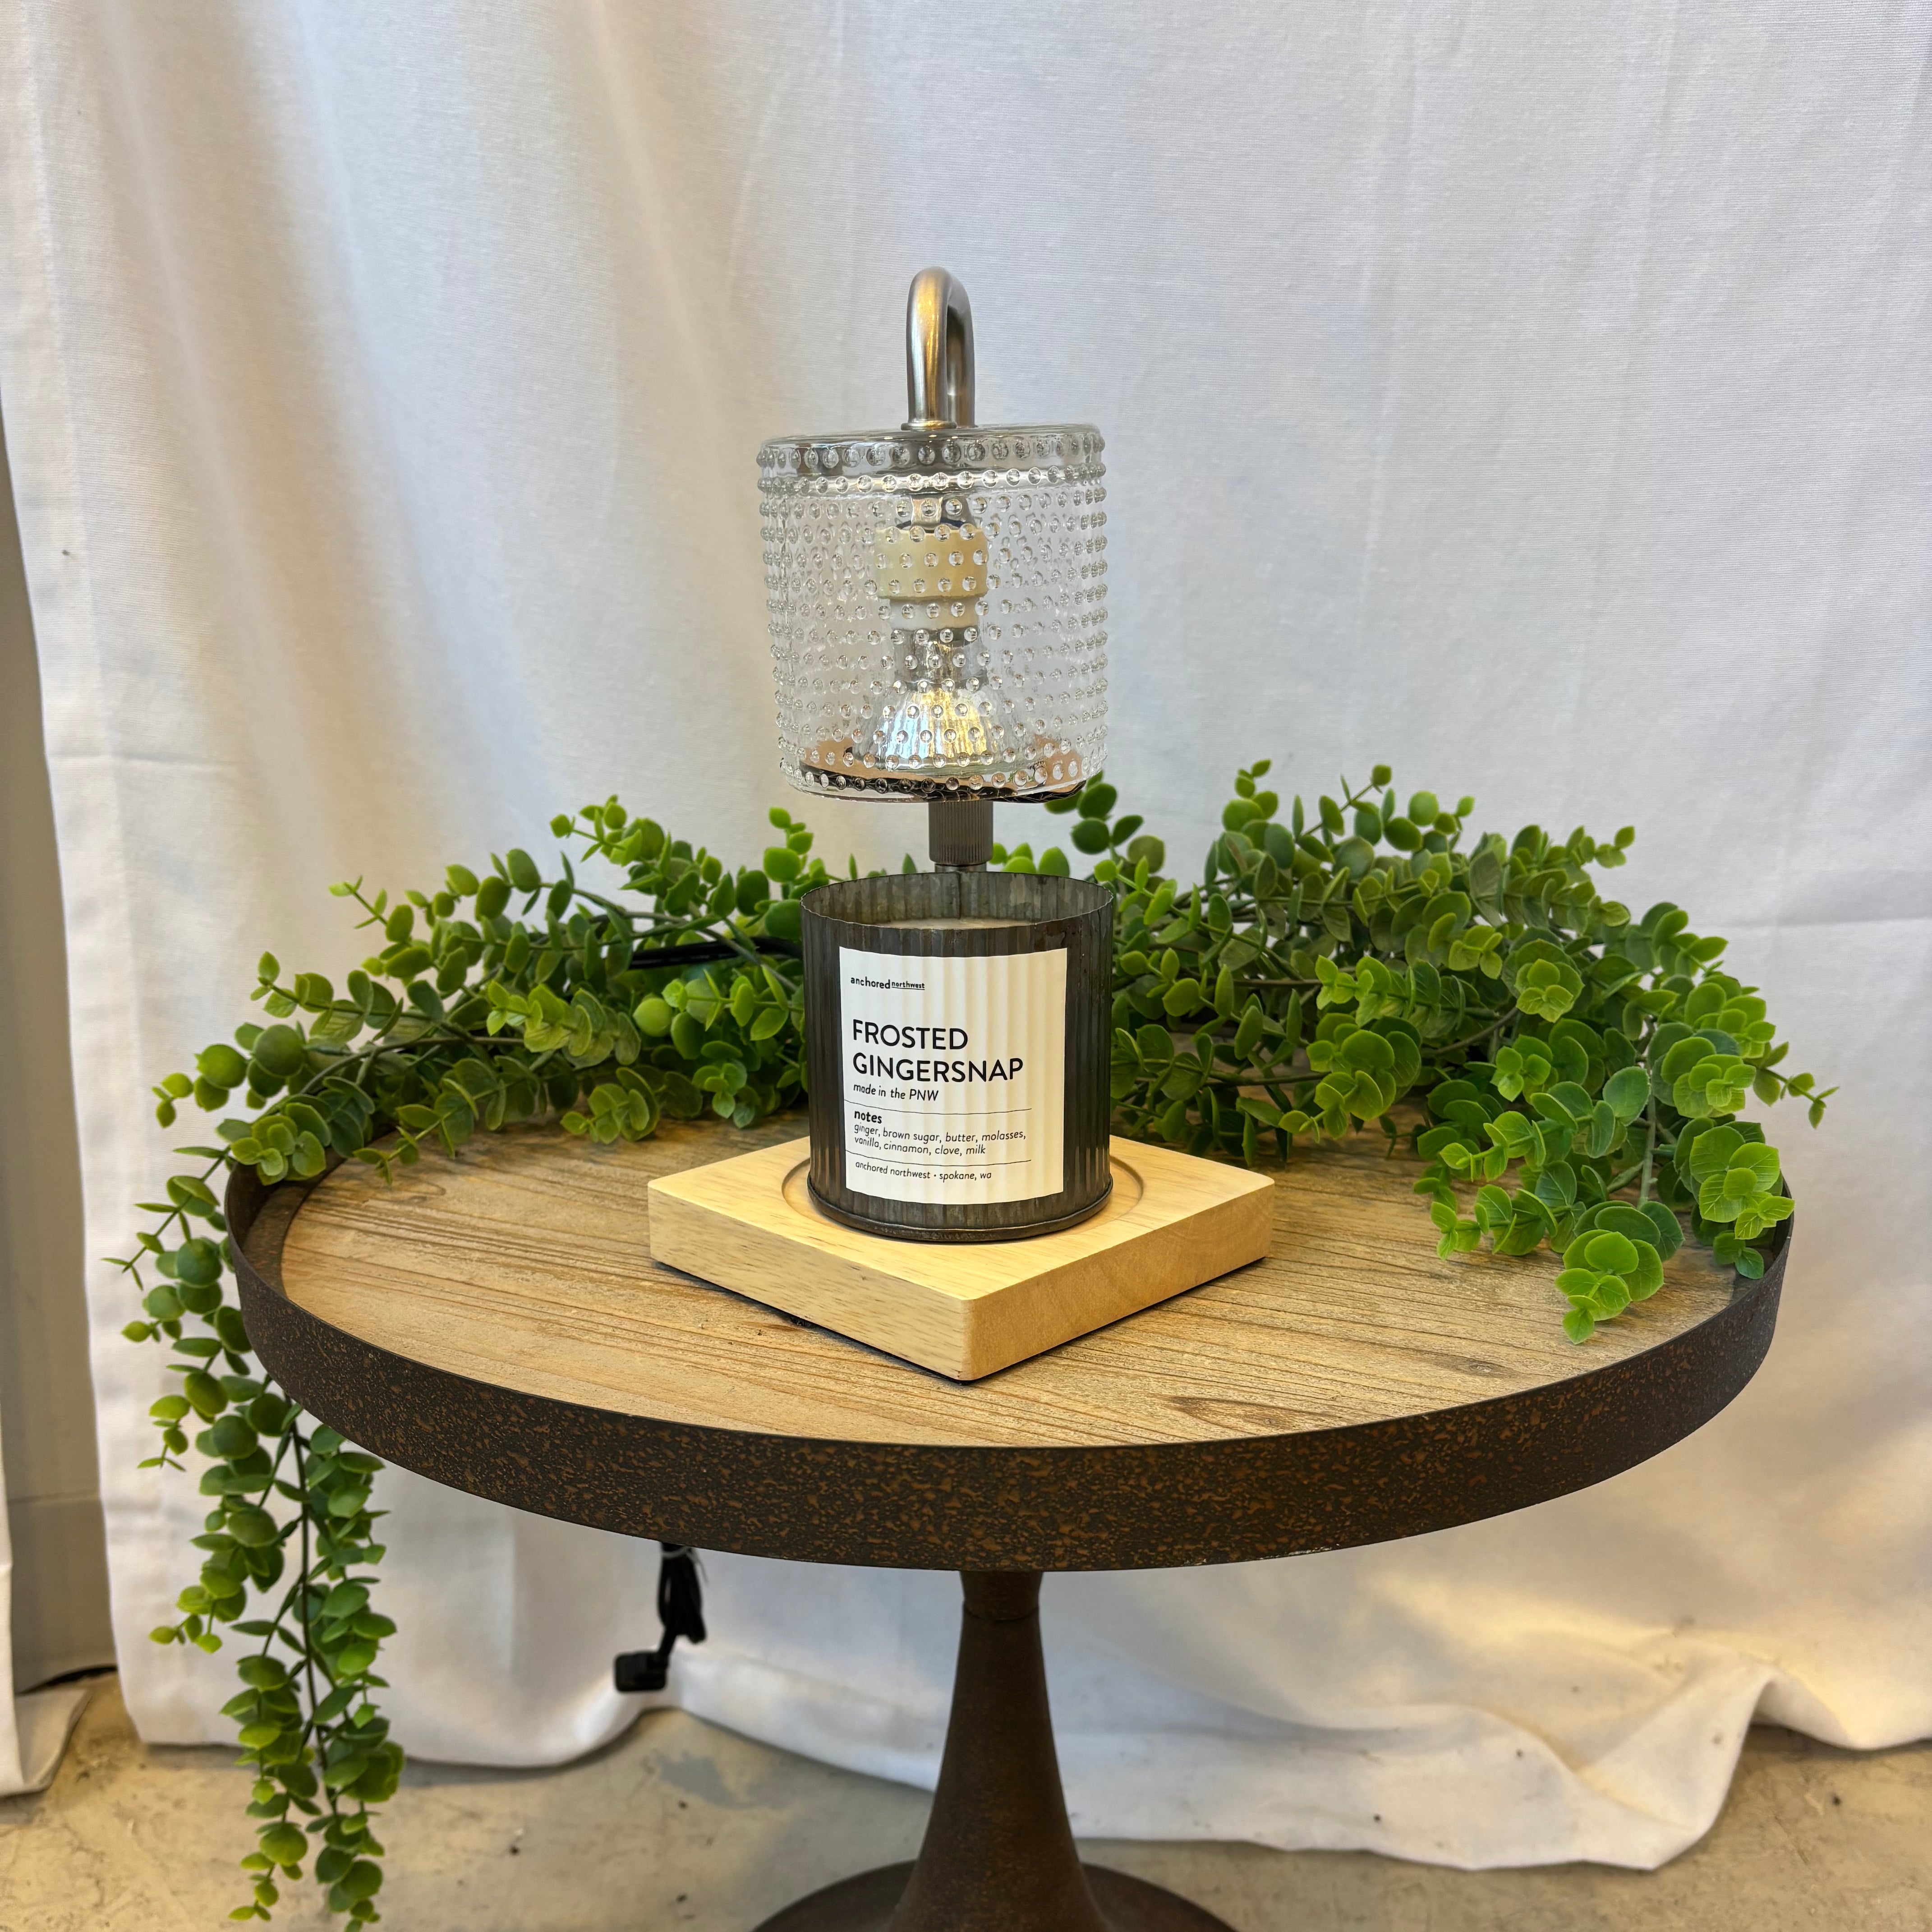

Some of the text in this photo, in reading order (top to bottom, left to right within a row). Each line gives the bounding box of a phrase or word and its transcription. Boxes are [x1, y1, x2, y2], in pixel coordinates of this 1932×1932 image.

[853, 1019, 968, 1050] FROSTED
[853, 1052, 1023, 1083] GINGERSNAP
[853, 1083, 938, 1101] made in the PNW
[854, 1109, 882, 1124] notes
[854, 1122, 1026, 1144] ginger, brown sugar, butter, molasses,
[855, 1135, 986, 1156] vanilla, cinnamon, clove, milk
[856, 1160, 888, 1174] anchored
[890, 1167, 930, 1179] northwest
[939, 1171, 977, 1183] spokane,
